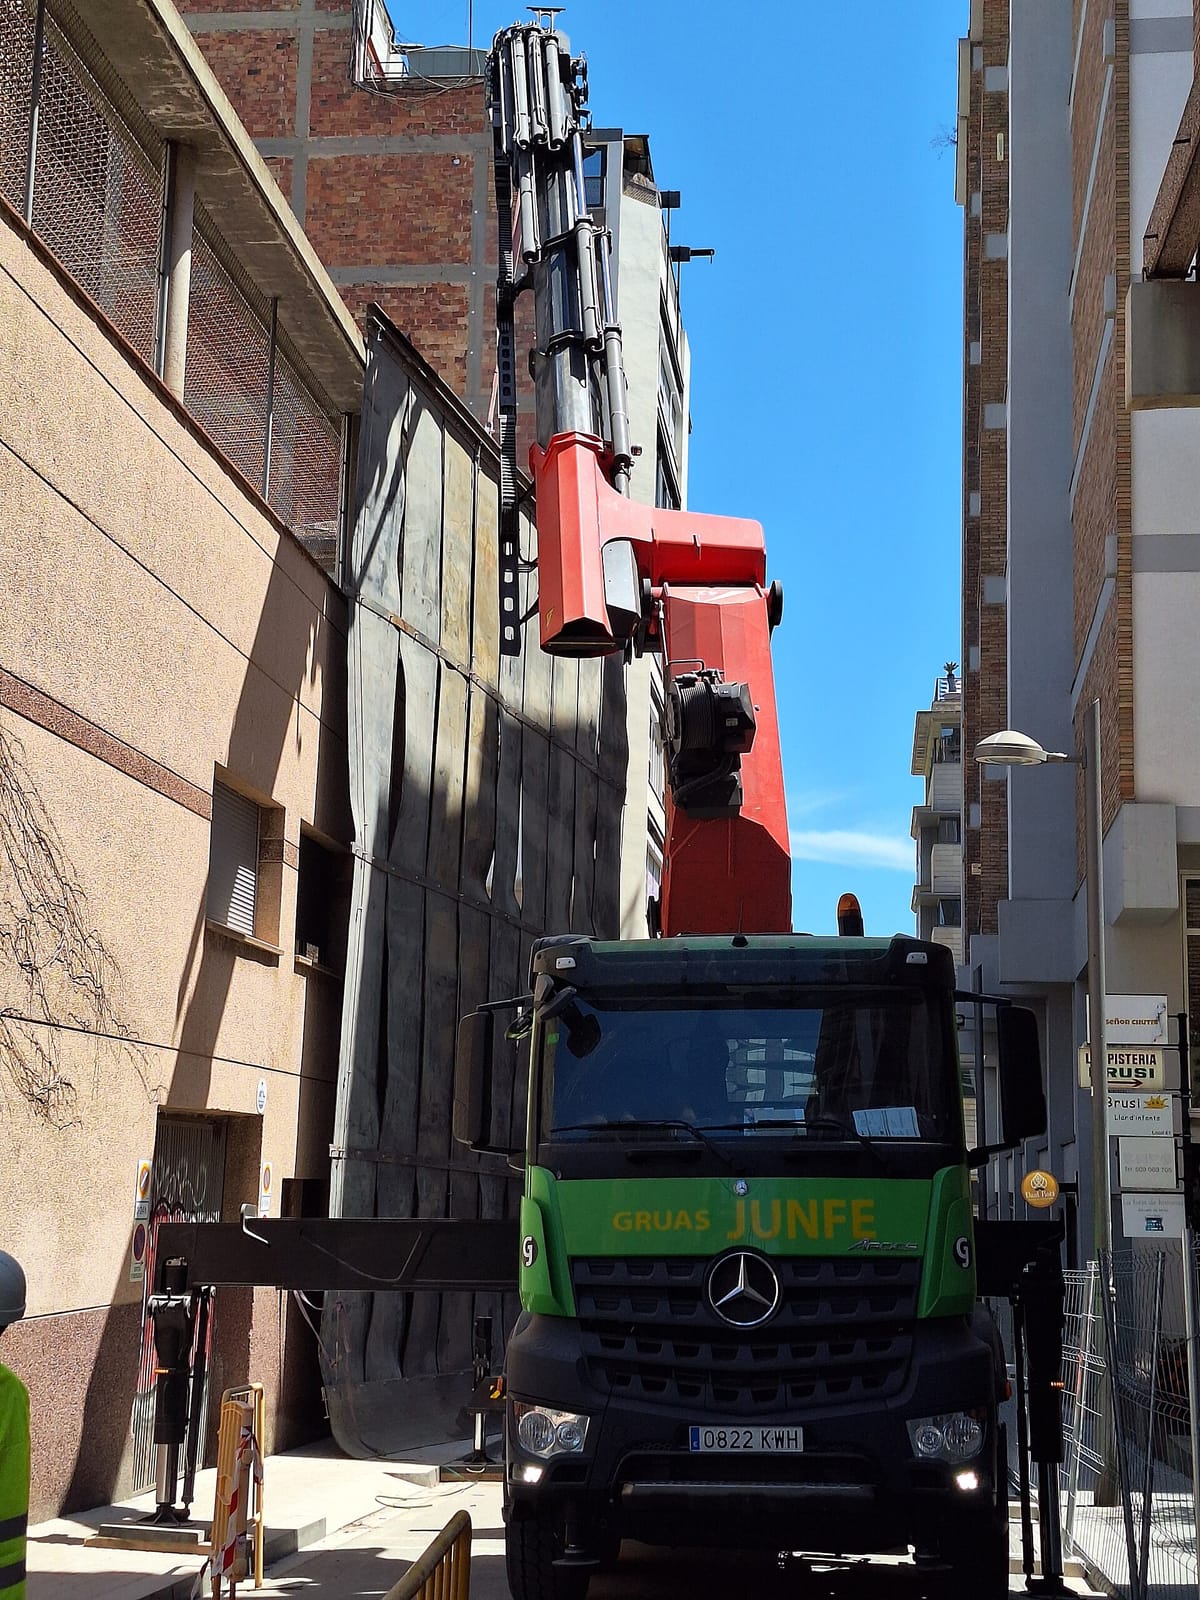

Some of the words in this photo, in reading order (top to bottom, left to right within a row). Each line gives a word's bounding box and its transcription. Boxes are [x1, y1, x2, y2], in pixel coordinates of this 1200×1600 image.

[1085, 1053, 1157, 1065] LPISTERIA
[1089, 1067, 1155, 1079] RUSI
[612, 1209, 711, 1232] GRUAS
[727, 1199, 877, 1240] JUNFE
[704, 1430, 754, 1449] 0822
[761, 1429, 799, 1449] KWH
